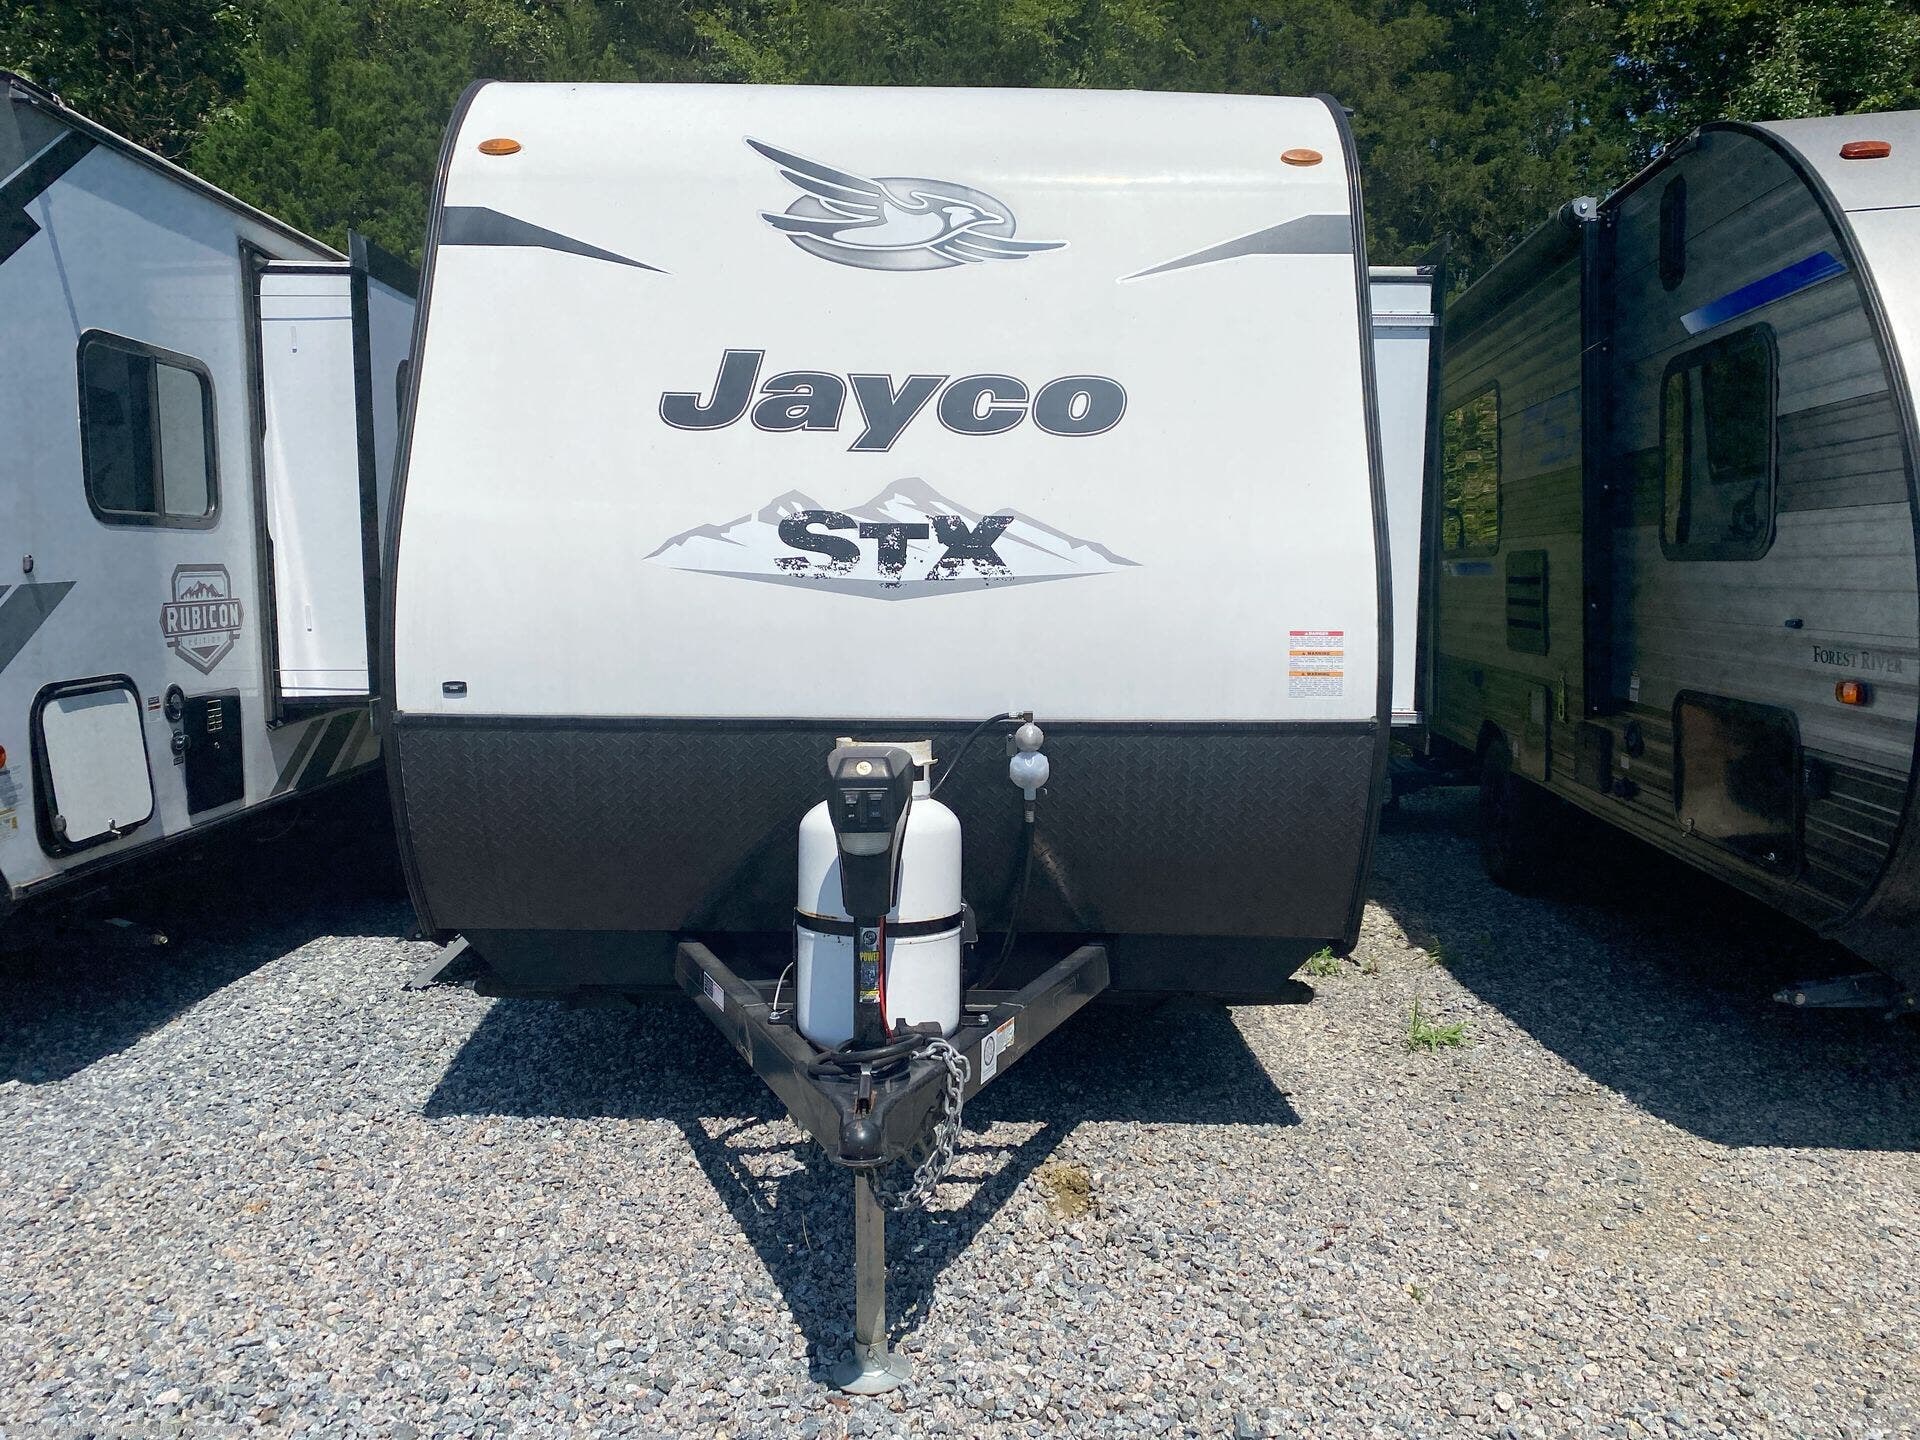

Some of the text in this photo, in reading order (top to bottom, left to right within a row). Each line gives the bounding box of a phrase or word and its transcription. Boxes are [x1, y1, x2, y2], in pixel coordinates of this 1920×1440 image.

[658, 348, 1128, 453] Jayco
[773, 509, 1016, 588] STX
[167, 603, 239, 633] RUBICON
